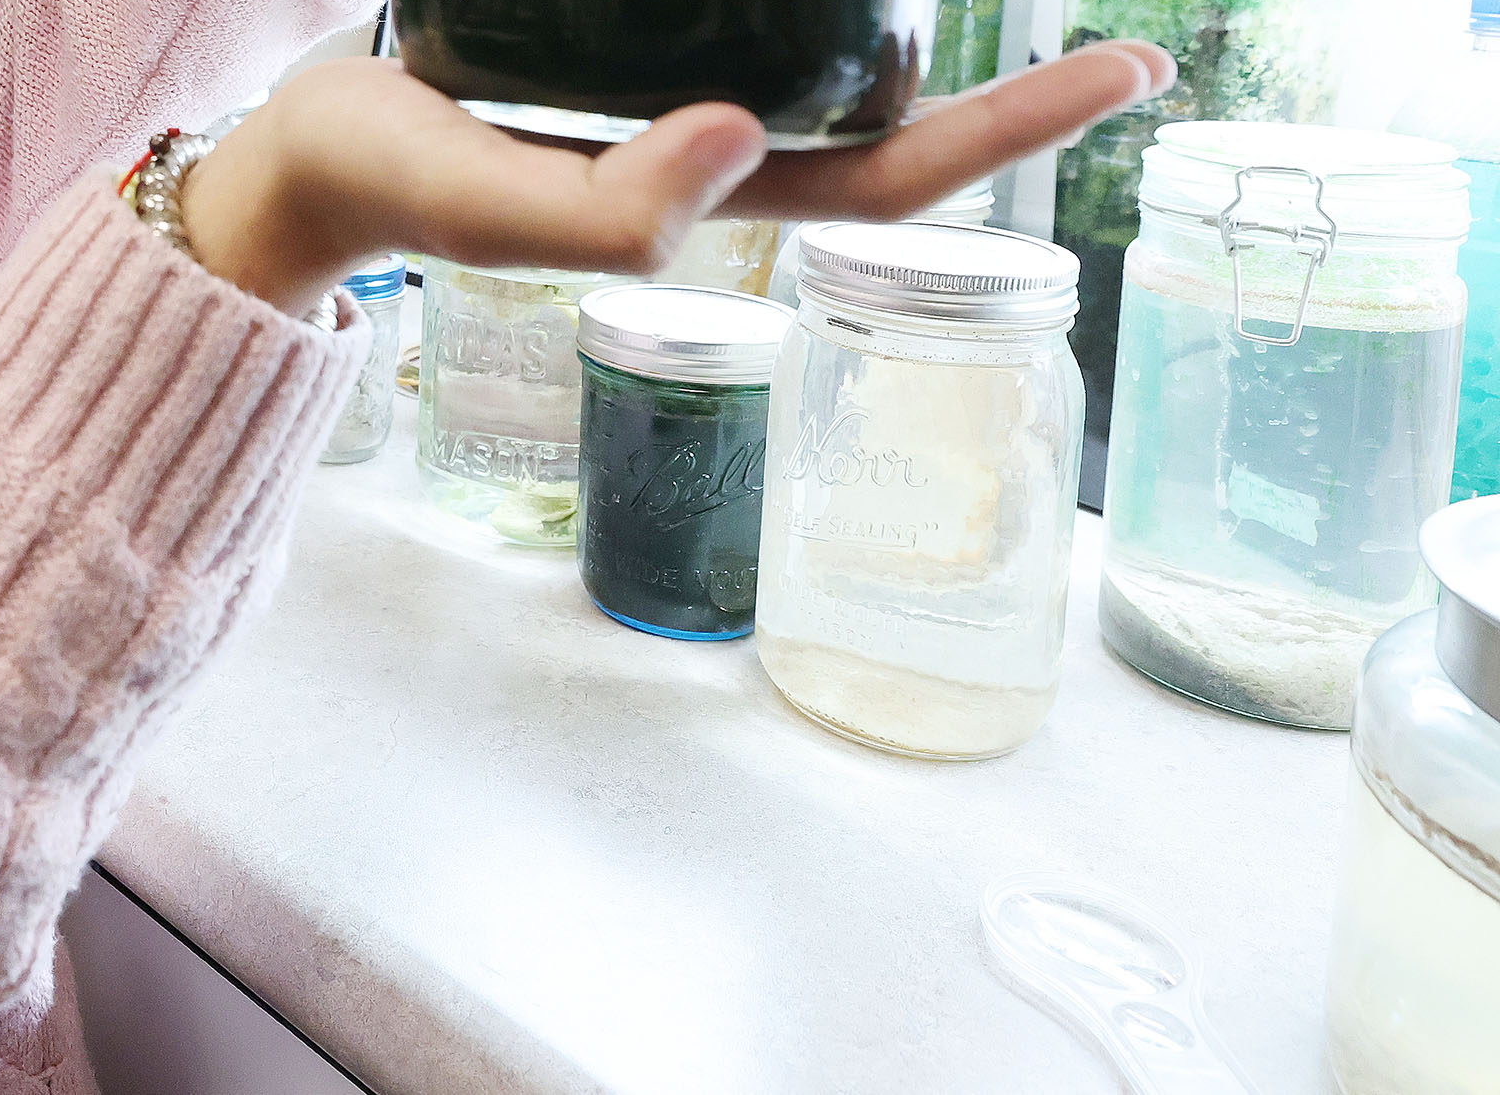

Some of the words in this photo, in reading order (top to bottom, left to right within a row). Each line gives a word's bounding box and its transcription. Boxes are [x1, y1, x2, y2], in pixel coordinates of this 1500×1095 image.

[432, 430, 540, 485] MASON
[628, 438, 766, 518] Ball
[782, 408, 929, 488] Kerr
